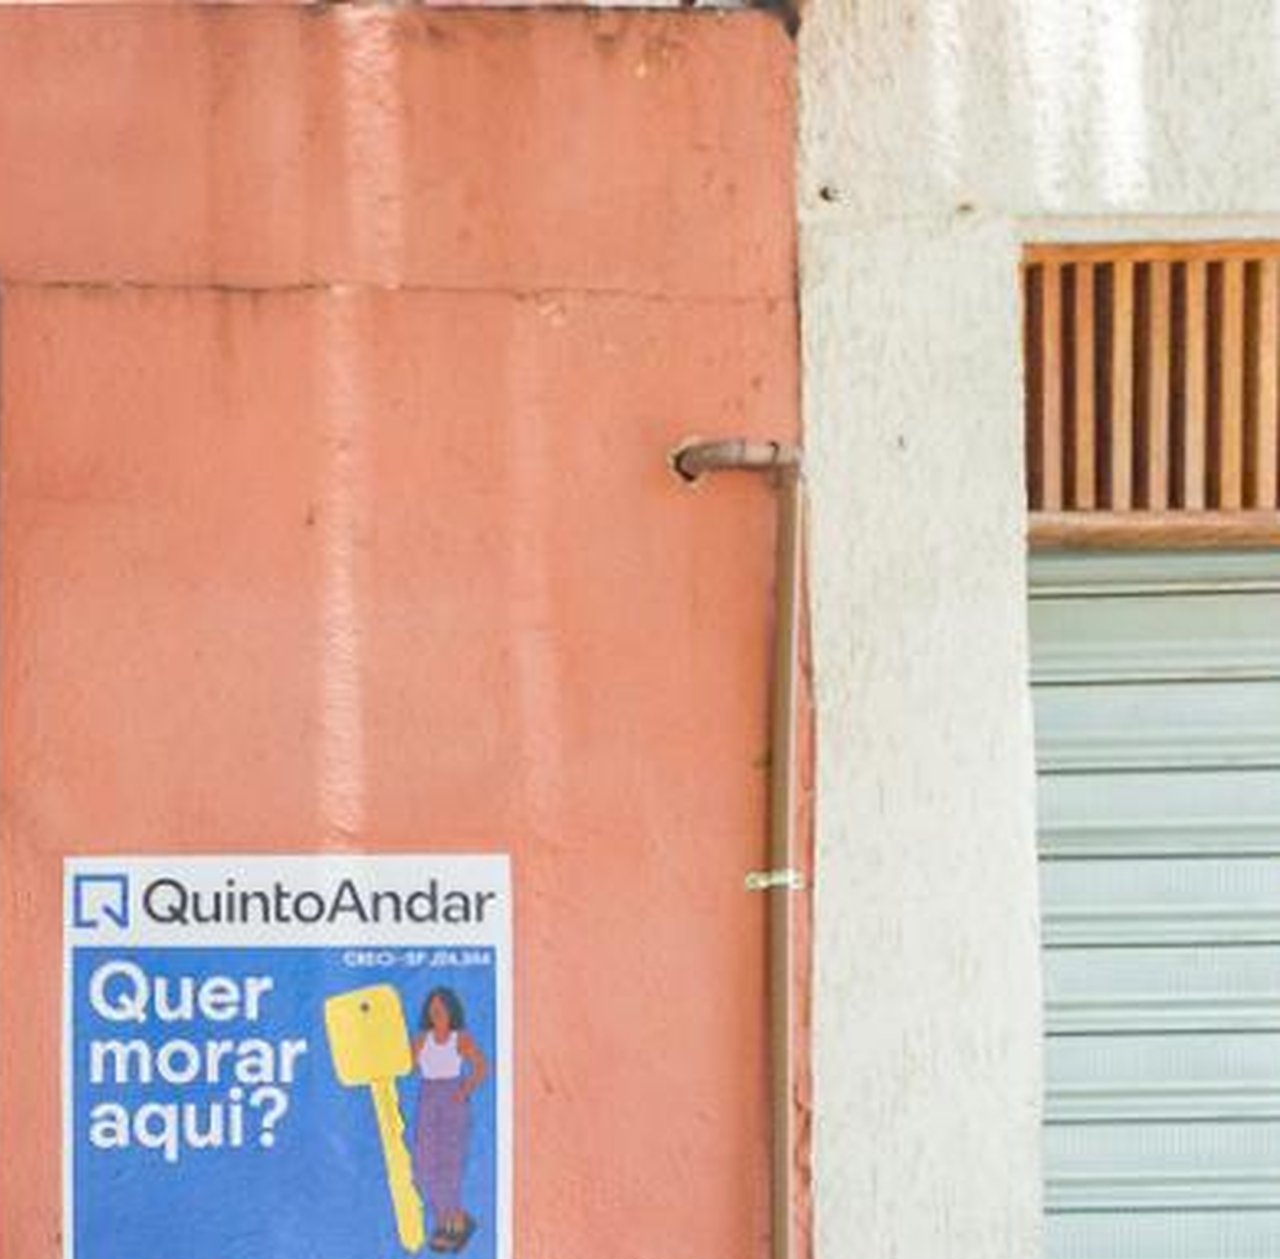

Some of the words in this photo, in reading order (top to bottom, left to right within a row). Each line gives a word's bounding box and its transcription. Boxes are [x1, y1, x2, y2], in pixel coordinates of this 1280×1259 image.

[142, 877, 496, 926] QuintoAndar
[89, 960, 274, 1024] Quer
[90, 1038, 308, 1084] morar
[89, 1086, 289, 1162] aqui?
